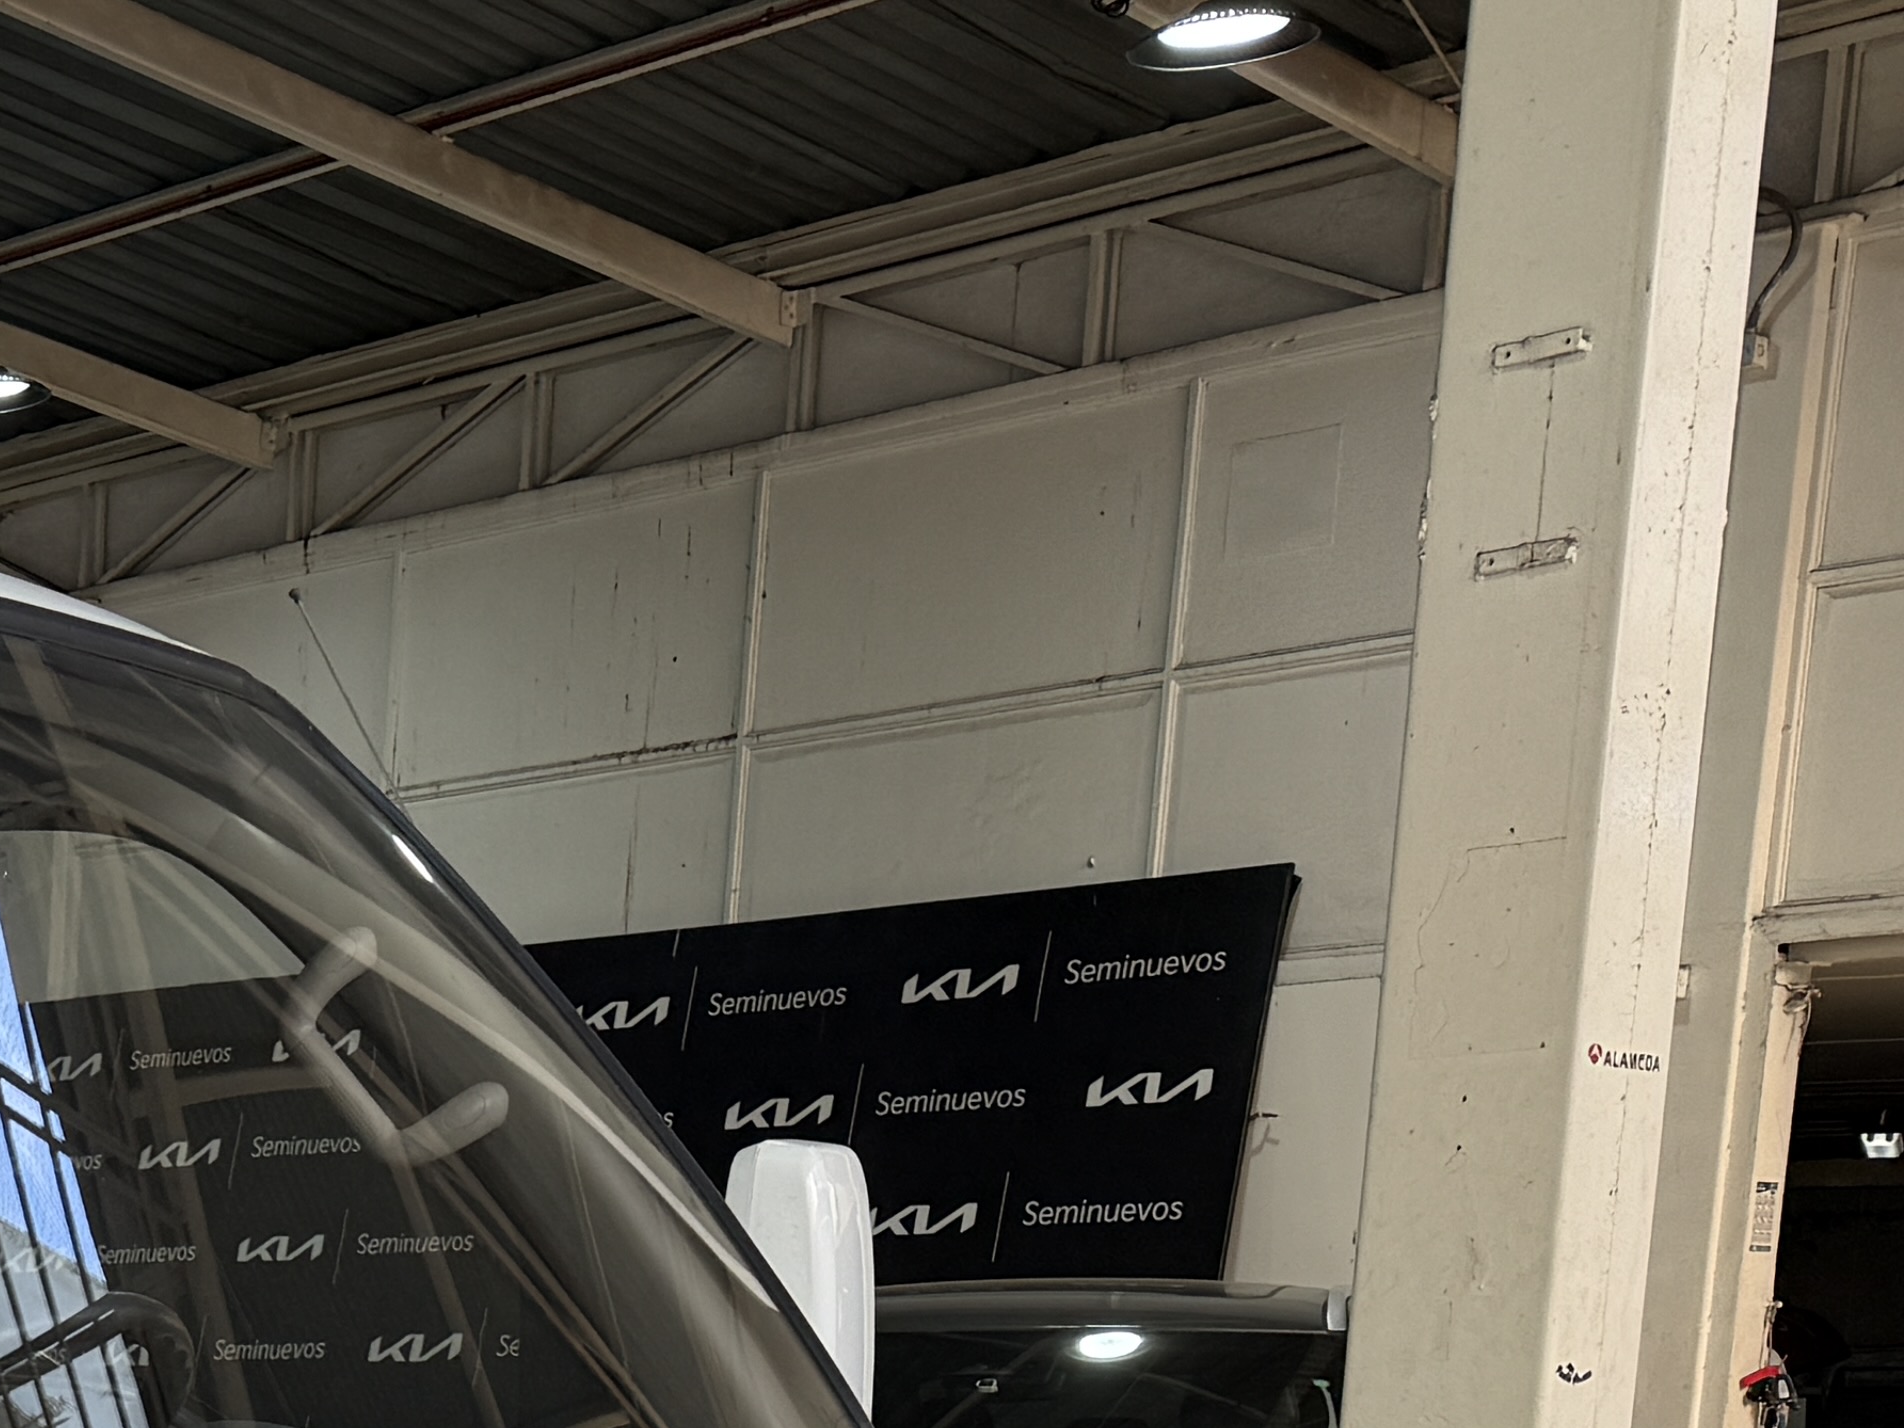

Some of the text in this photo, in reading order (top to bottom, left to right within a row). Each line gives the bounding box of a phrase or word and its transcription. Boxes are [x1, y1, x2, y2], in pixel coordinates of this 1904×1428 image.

[1064, 951, 1227, 985] Seminuevos
[707, 987, 848, 1017] Seminuevos
[129, 1046, 232, 1070] Seminuevos
[875, 1088, 1026, 1116] Seminuevos
[251, 1136, 361, 1158] Seminuevos
[1022, 1200, 1184, 1226] Seminuevos
[357, 1233, 475, 1256] Seminuevos
[213, 1339, 327, 1361] Seminuevos
